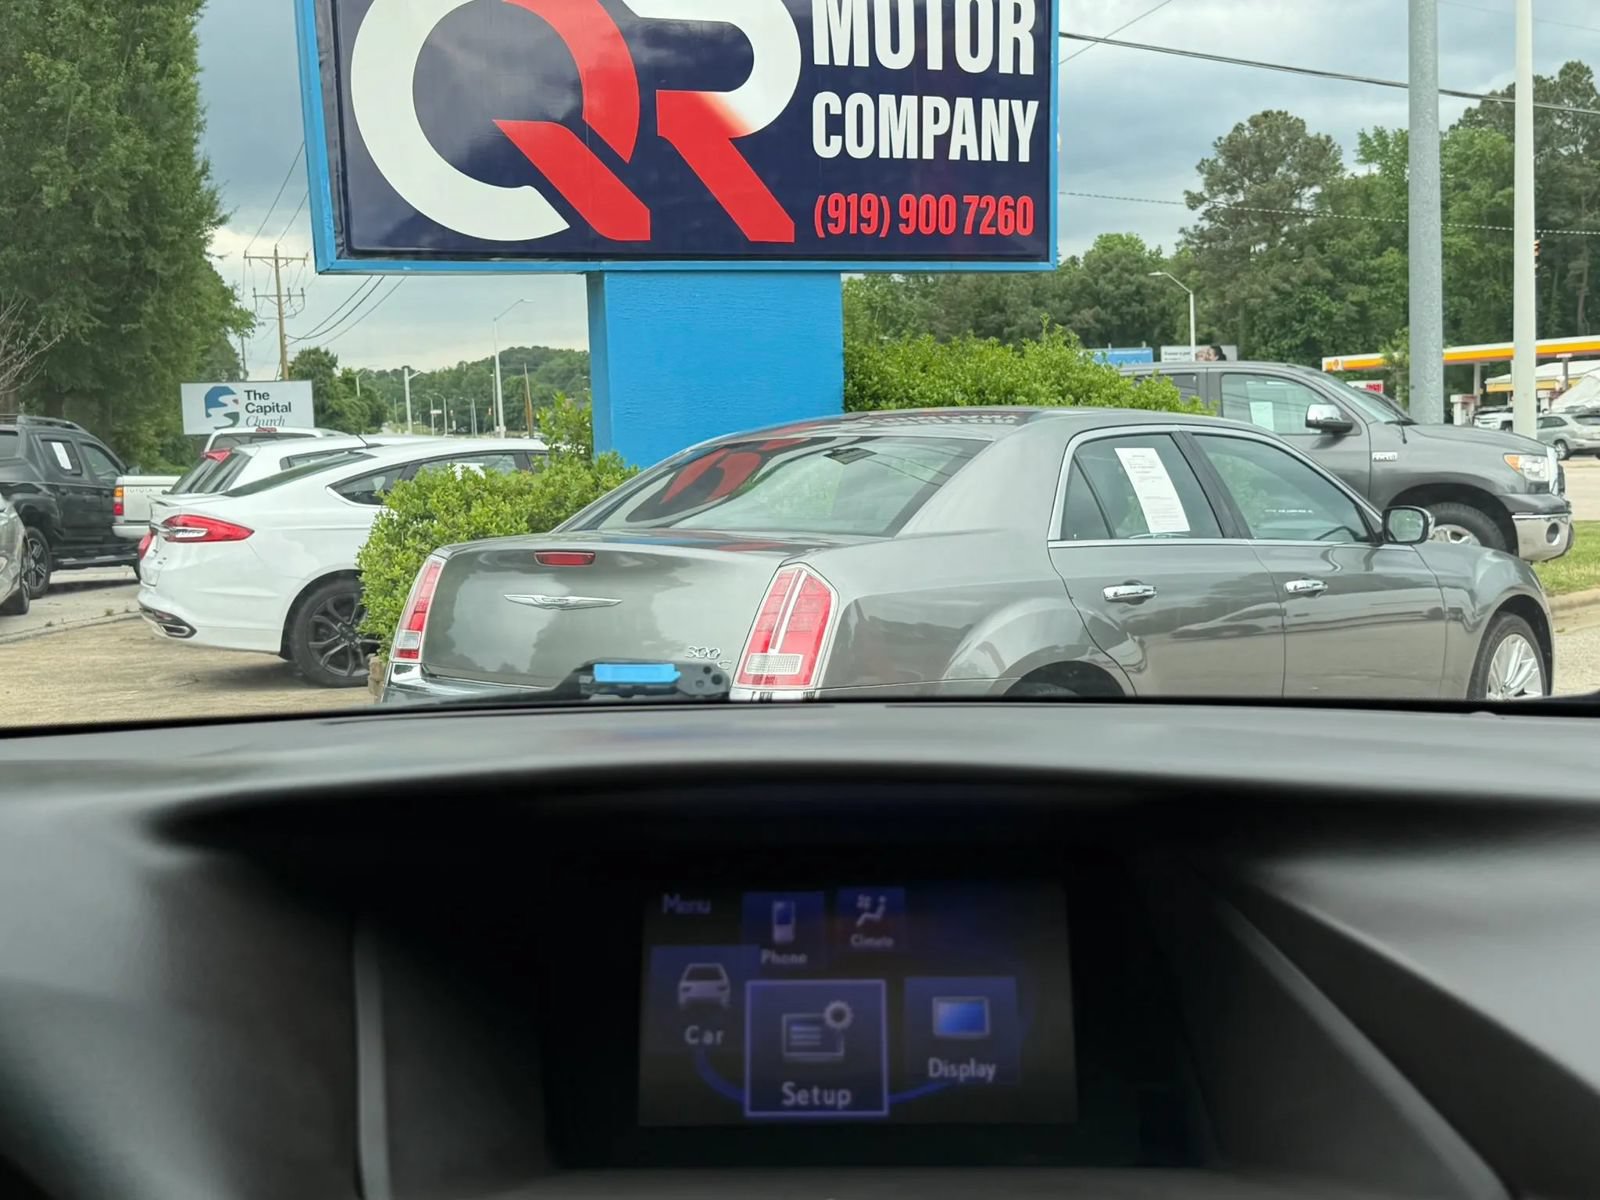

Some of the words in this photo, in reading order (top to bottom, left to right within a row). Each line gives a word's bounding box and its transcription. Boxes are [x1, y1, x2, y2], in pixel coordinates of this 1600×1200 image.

[812, 0, 1036, 75] MOTOR
[812, 91, 1039, 162] COMPANY
[814, 193, 891, 238] (919)
[898, 194, 957, 235] 900
[963, 195, 1034, 236] 7260
[244, 390, 270, 400] The
[245, 402, 292, 415] Capital
[246, 415, 285, 427] Church
[685, 646, 721, 659] 300
[662, 893, 712, 915] Menu
[761, 949, 808, 966] Phone
[684, 1025, 724, 1046] Car
[928, 1058, 997, 1081] Display
[781, 1081, 852, 1109] Setup
